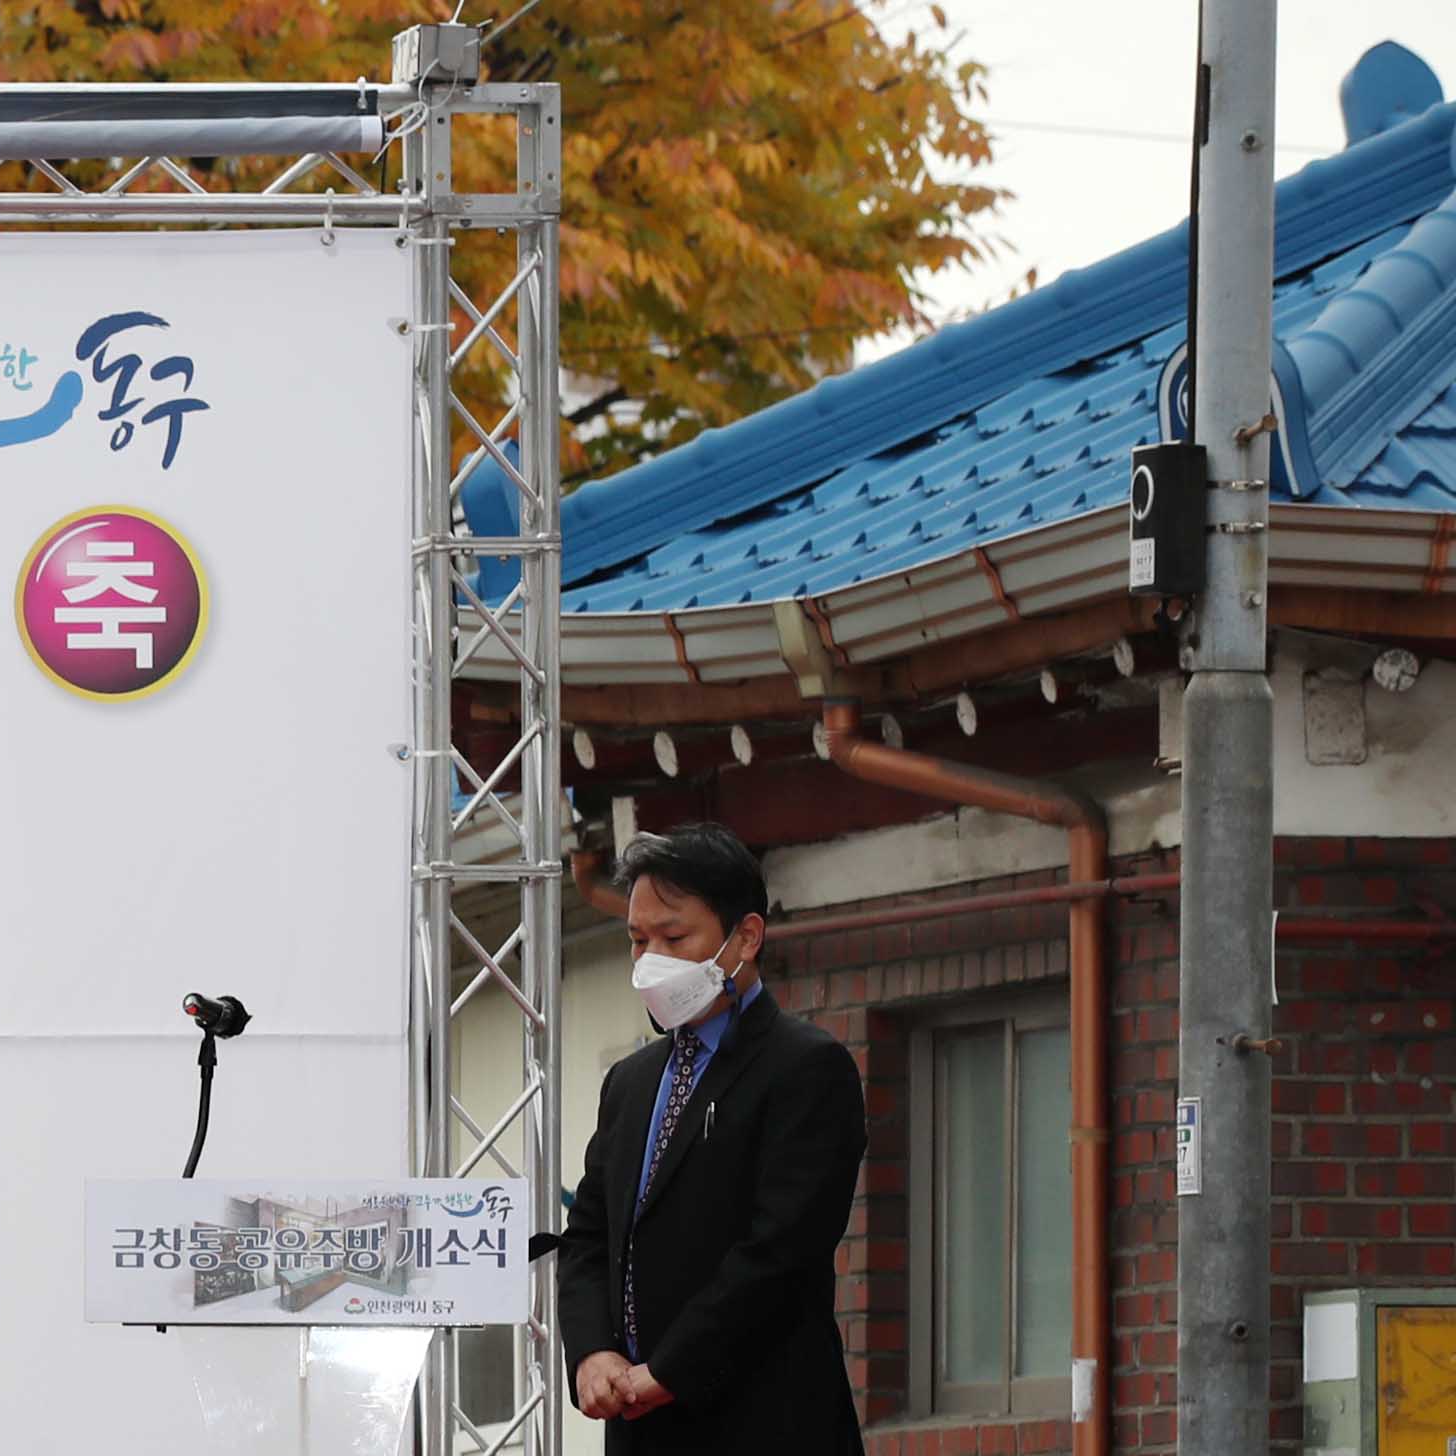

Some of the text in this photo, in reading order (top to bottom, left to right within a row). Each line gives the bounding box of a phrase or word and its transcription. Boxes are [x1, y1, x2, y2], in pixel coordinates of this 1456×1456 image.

[75, 311, 210, 470] 동구
[53, 541, 167, 670] 축
[111, 1227, 507, 1271] 금창동 공유주방 개소식
